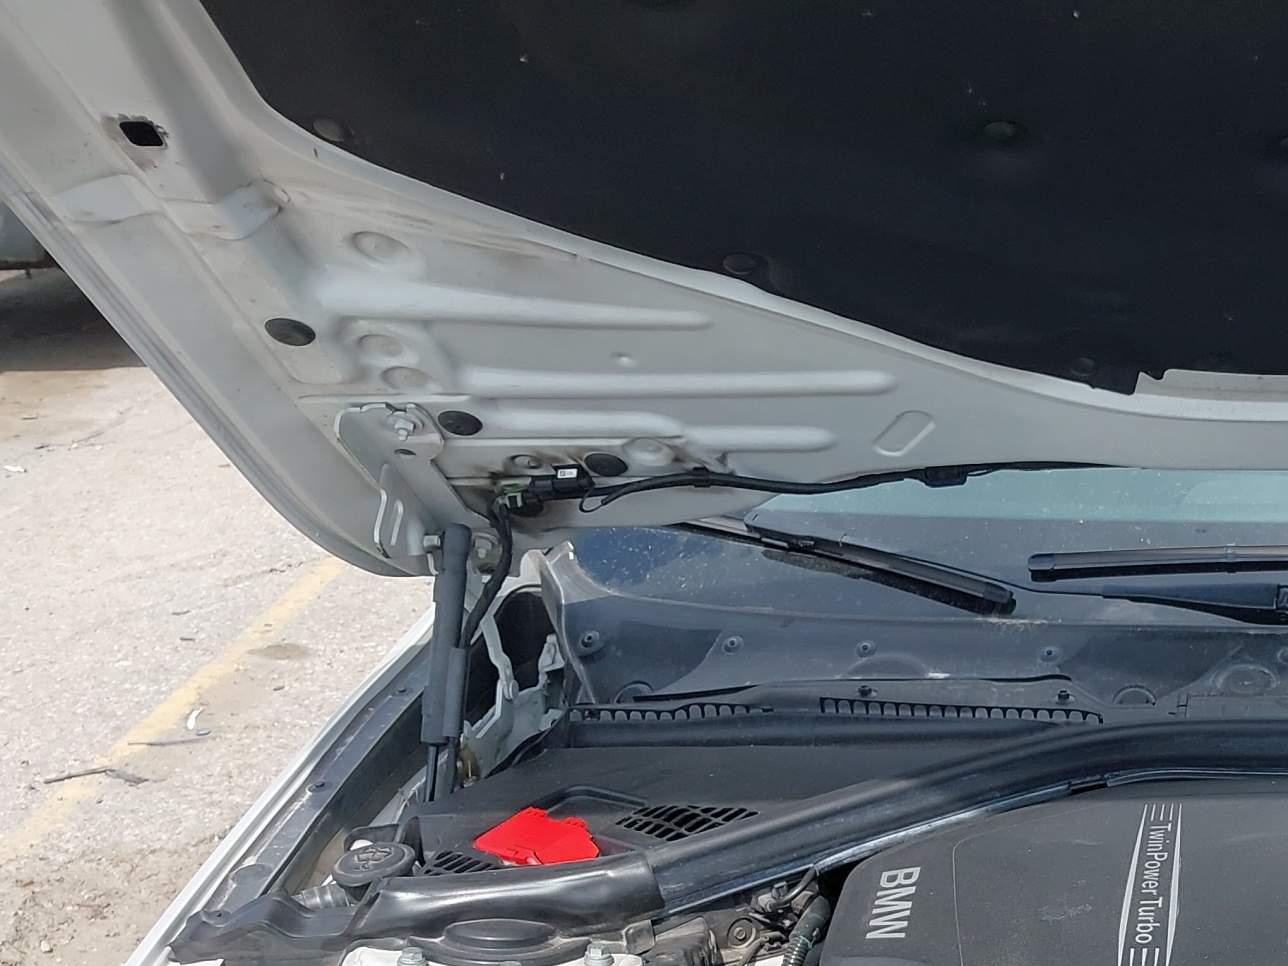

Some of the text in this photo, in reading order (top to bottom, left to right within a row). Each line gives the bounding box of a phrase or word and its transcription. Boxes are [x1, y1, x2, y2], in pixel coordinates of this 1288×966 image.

[865, 866, 921, 939] BMW
[1135, 822, 1172, 944] TwinPower Turbo
